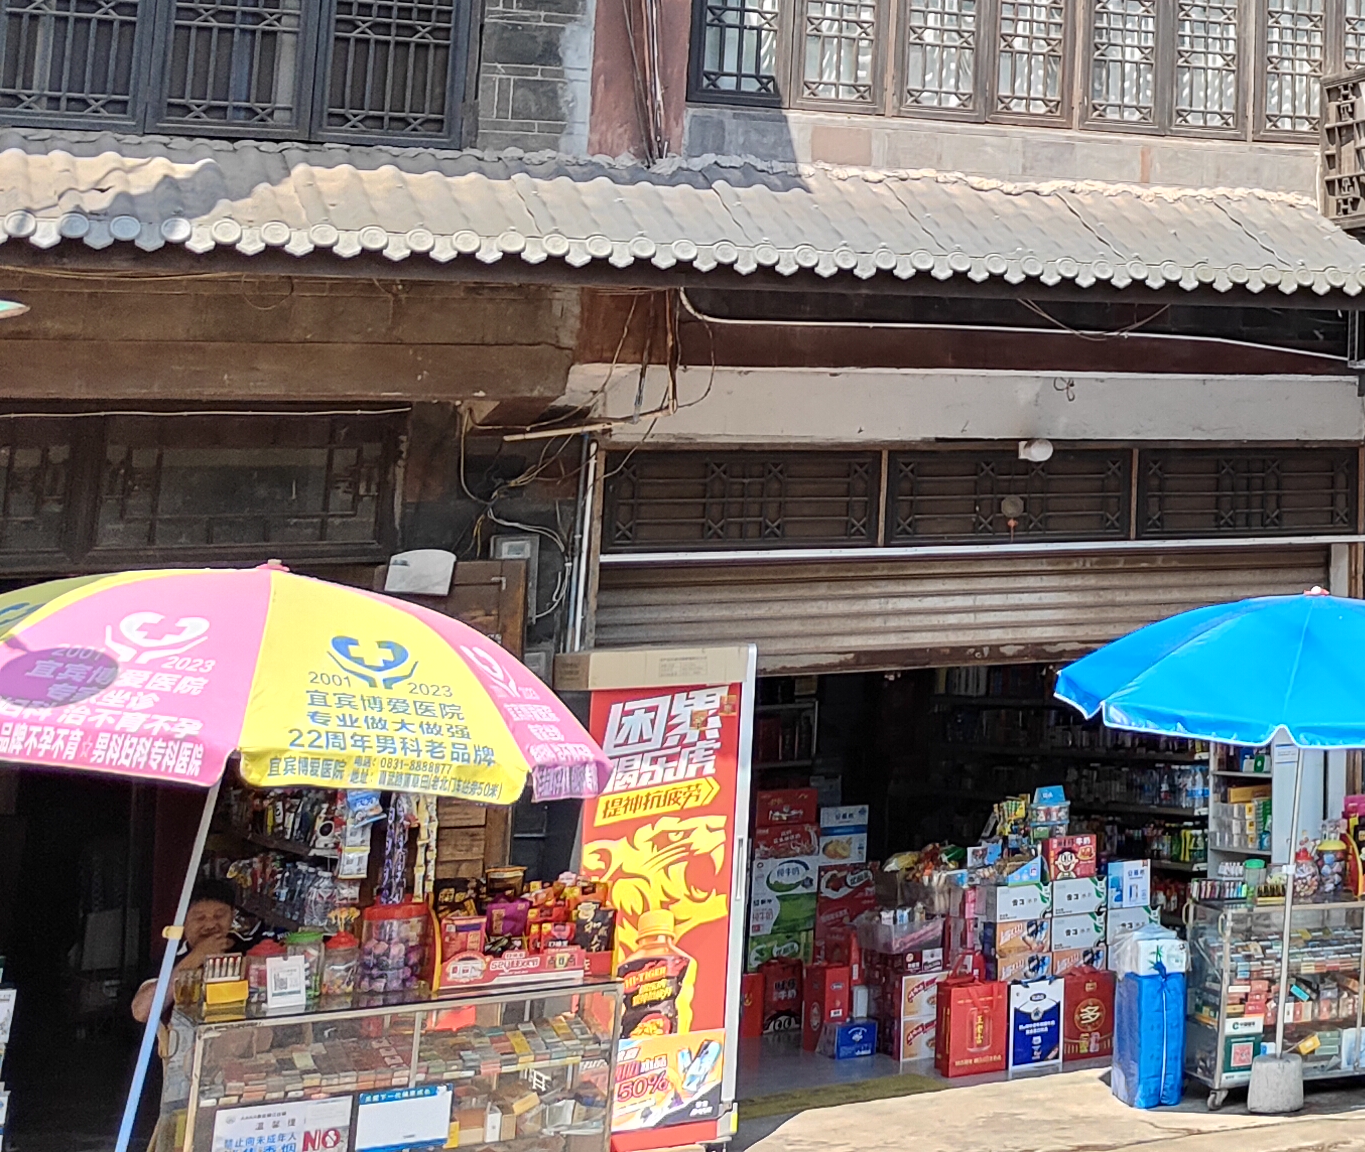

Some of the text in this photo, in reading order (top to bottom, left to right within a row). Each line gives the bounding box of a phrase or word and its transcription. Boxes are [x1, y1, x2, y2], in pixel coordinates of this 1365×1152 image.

[51, 643, 106, 660] 2001
[25, 659, 209, 696] 宜宾博爱医院
[161, 656, 216, 674] 2023
[308, 671, 352, 688] 2001
[408, 682, 453, 698] 2023
[46, 683, 160, 711] 专家坐诊
[305, 689, 465, 721] 宜宾博爱医院
[58, 705, 204, 739] 治不育不孕
[306, 711, 472, 740] 专业做大做强
[602, 685, 729, 757] 困累
[288, 729, 496, 767] 22周年男科老品牌
[267, 756, 347, 781] 宜宾博爱医院
[602, 783, 702, 819] 提神抗疲劳
[624, 965, 668, 989] HI-TIGER
[1080, 1006, 1100, 1024] 多
[254, 1118, 306, 1132] 温馨提
[224, 1131, 297, 1149] 禁止向未成年人
